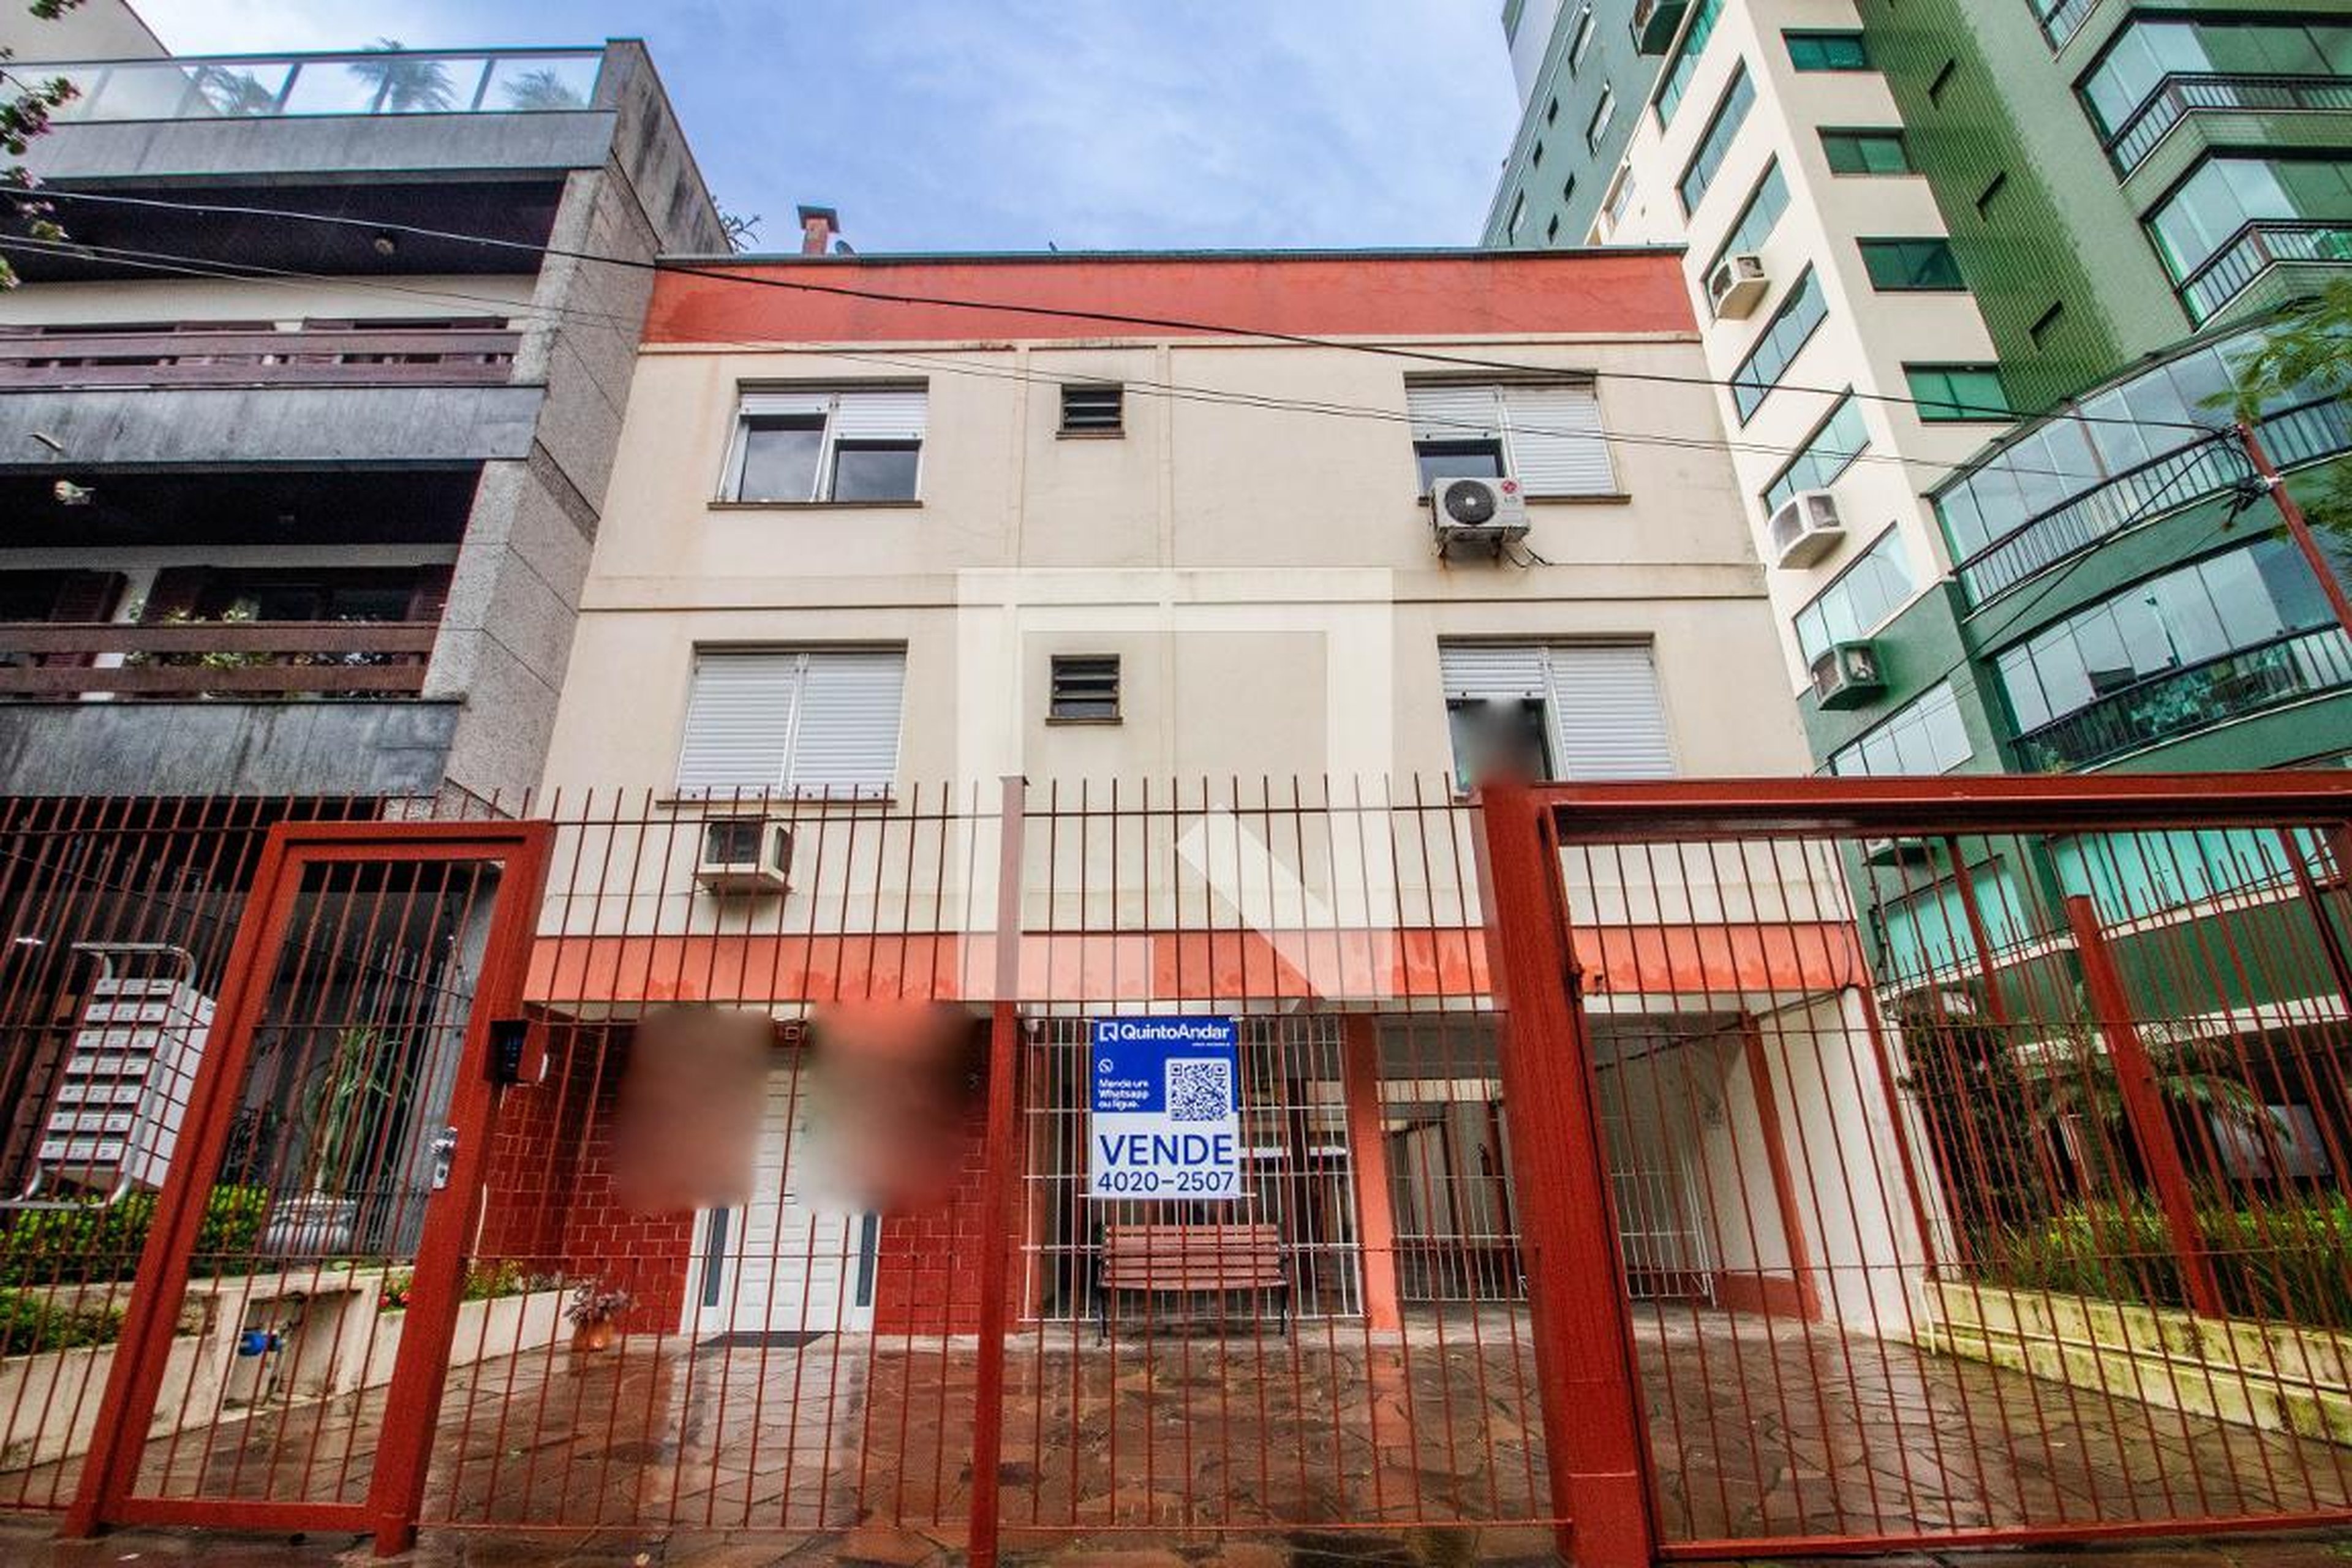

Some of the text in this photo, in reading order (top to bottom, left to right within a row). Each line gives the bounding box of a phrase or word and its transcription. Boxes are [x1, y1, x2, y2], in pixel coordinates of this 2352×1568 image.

[1120, 1023, 1230, 1040] QuintoAndar
[1099, 1134, 1234, 1165] VENDE
[1098, 1171, 1234, 1191] 4020-2507
